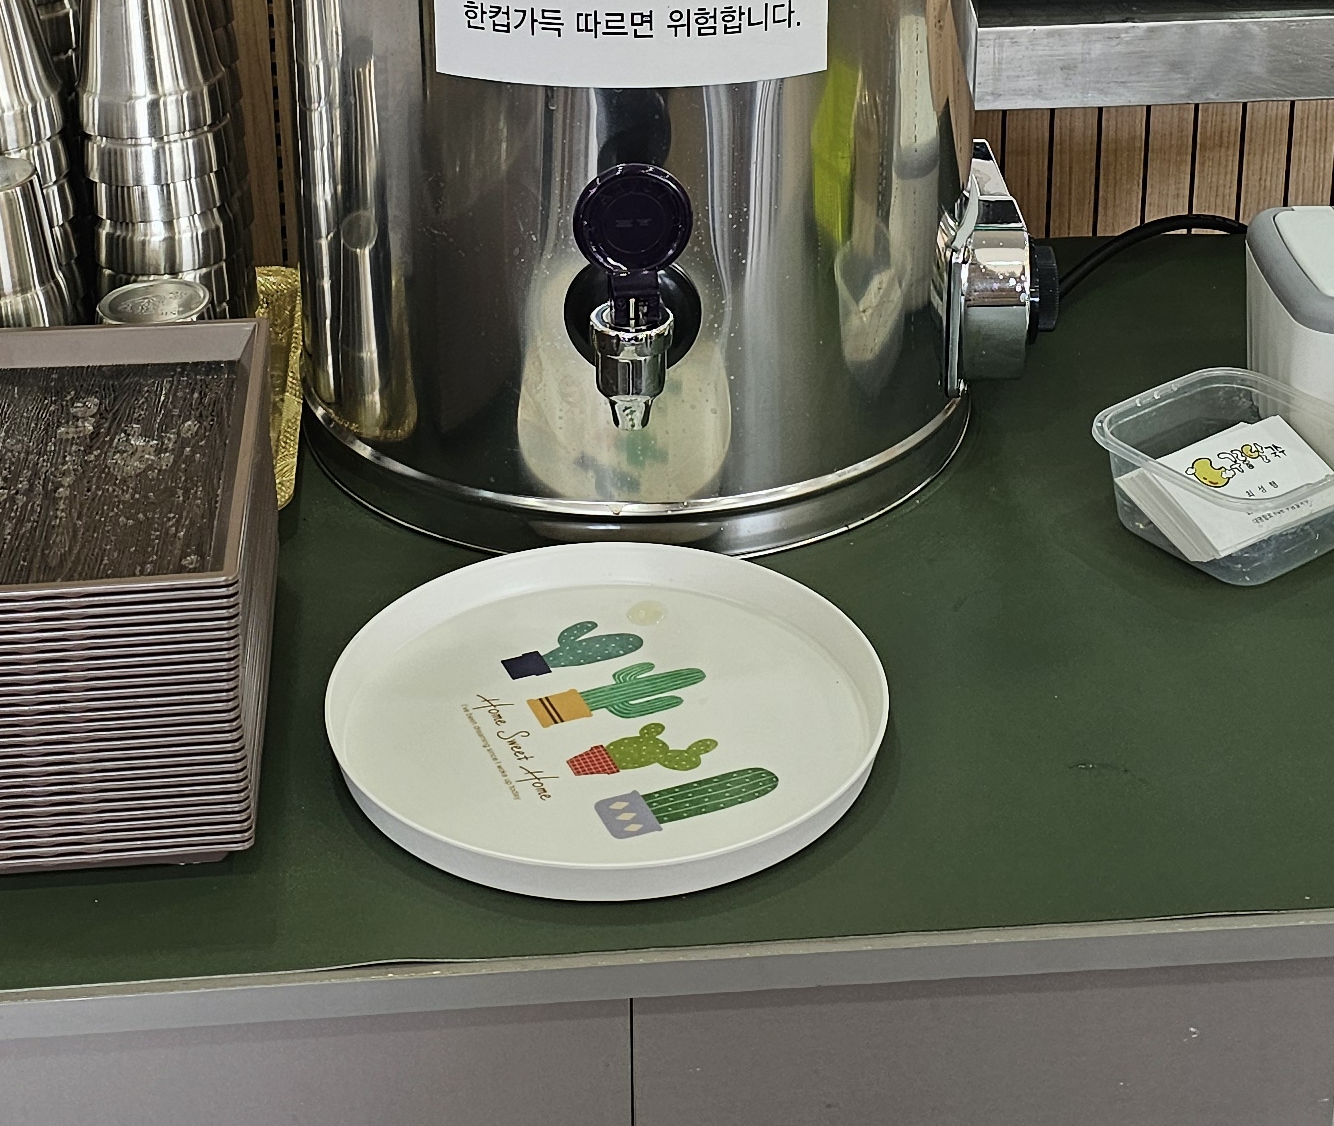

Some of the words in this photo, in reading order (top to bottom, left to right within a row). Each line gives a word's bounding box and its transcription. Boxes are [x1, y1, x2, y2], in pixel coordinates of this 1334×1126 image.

[463, 0, 565, 38] 한컵가득
[575, 10, 654, 39] 따르면
[666, 0, 802, 38] 위험합니다.
[472, 694, 514, 726] Home
[496, 730, 534, 761] Sweet
[515, 765, 560, 801] Home
